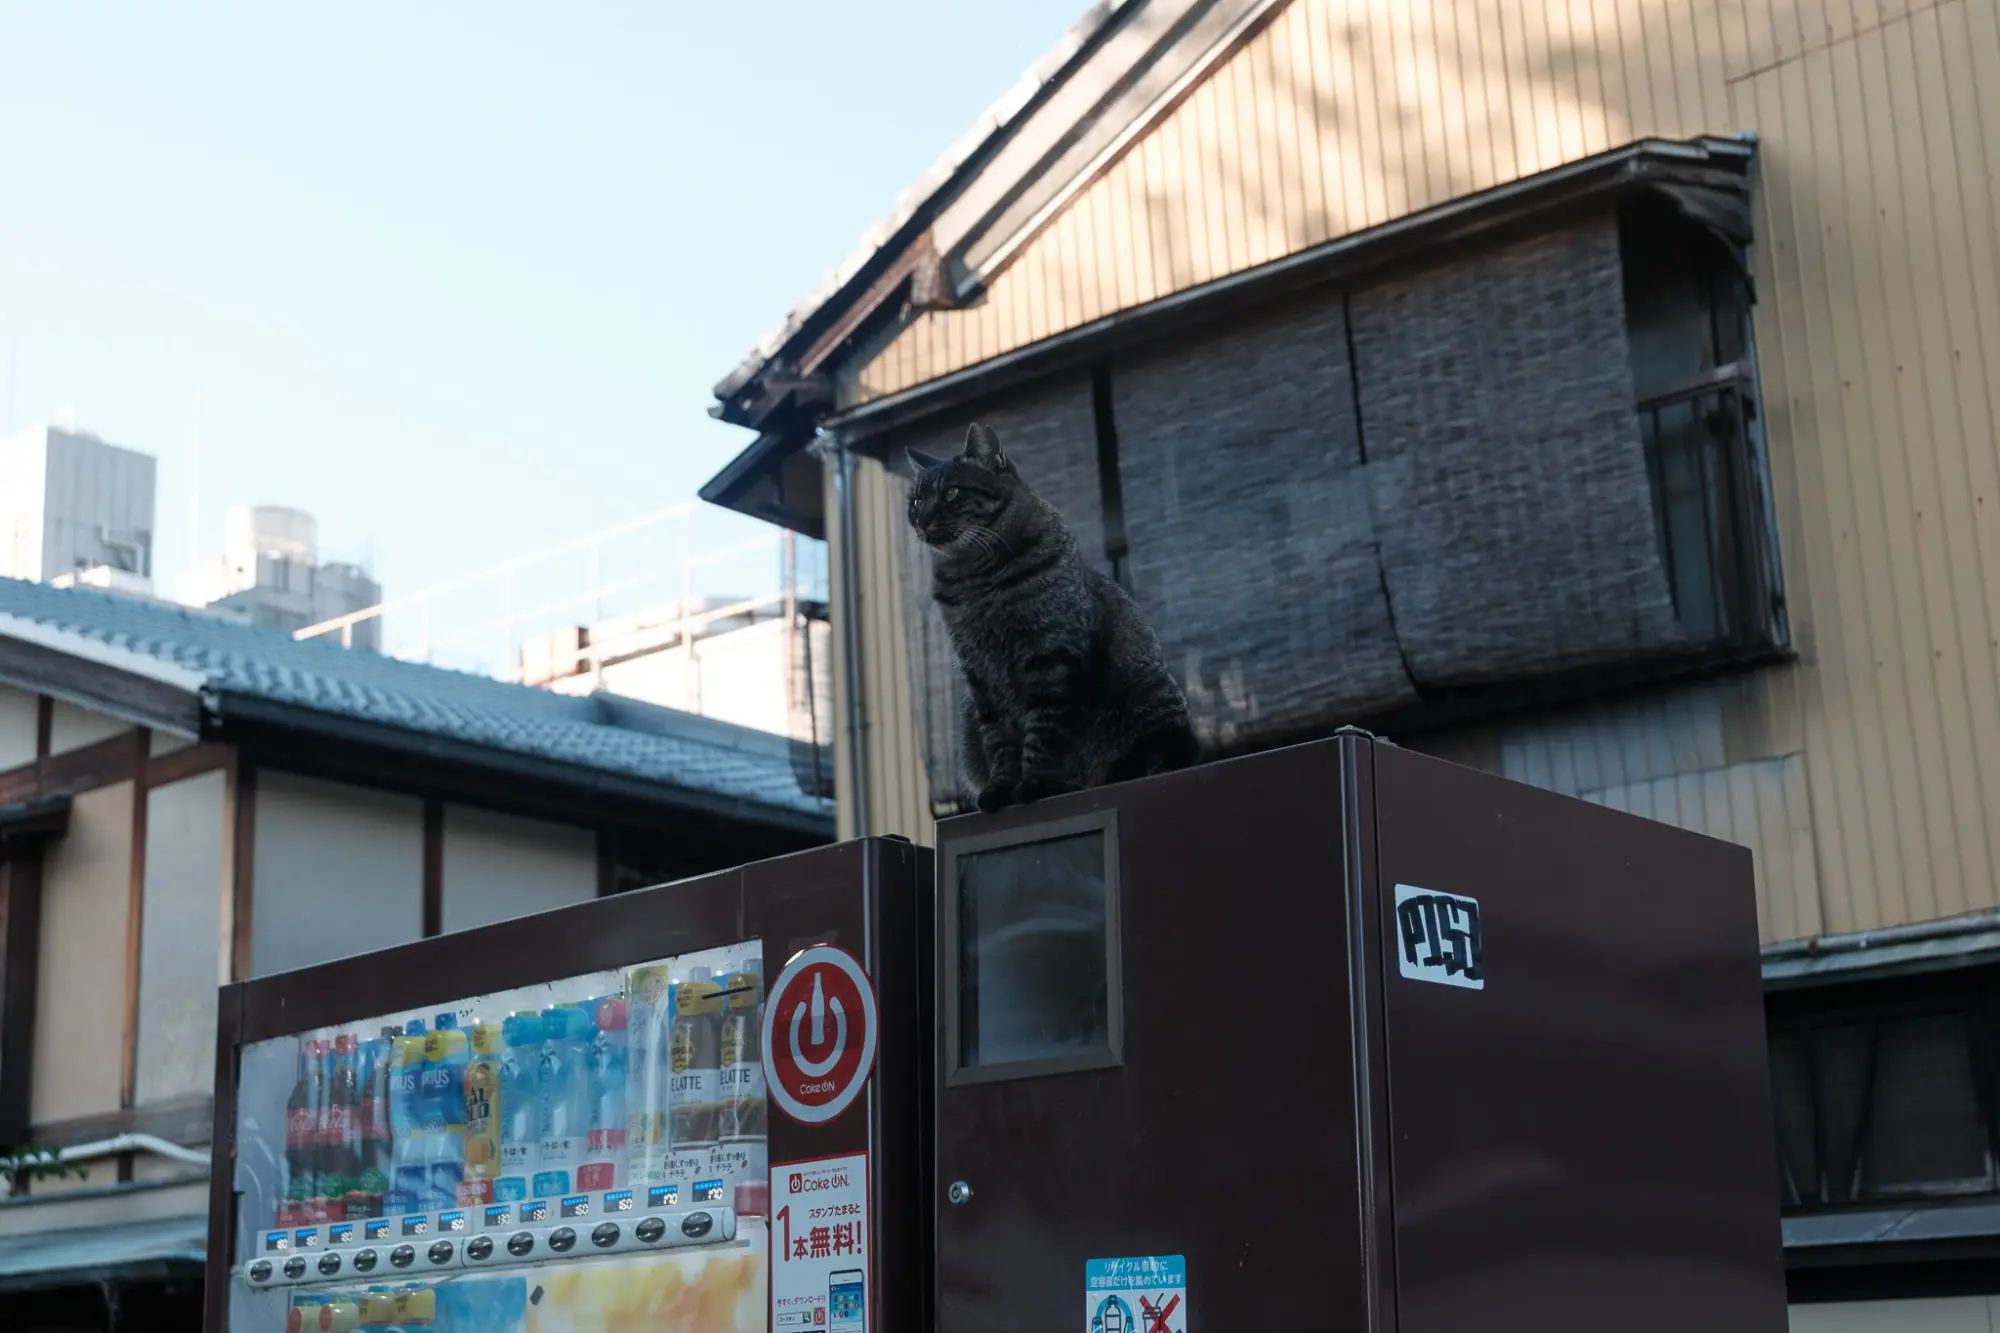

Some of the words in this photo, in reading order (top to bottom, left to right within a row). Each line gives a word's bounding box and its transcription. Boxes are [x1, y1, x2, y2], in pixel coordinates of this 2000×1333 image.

[800, 1082, 820, 1095] Coke
[821, 1080, 835, 1092] ON
[804, 1177, 830, 1192] Coke
[831, 1173, 849, 1189] ON
[809, 1203, 861, 1219] スタンプたまると
